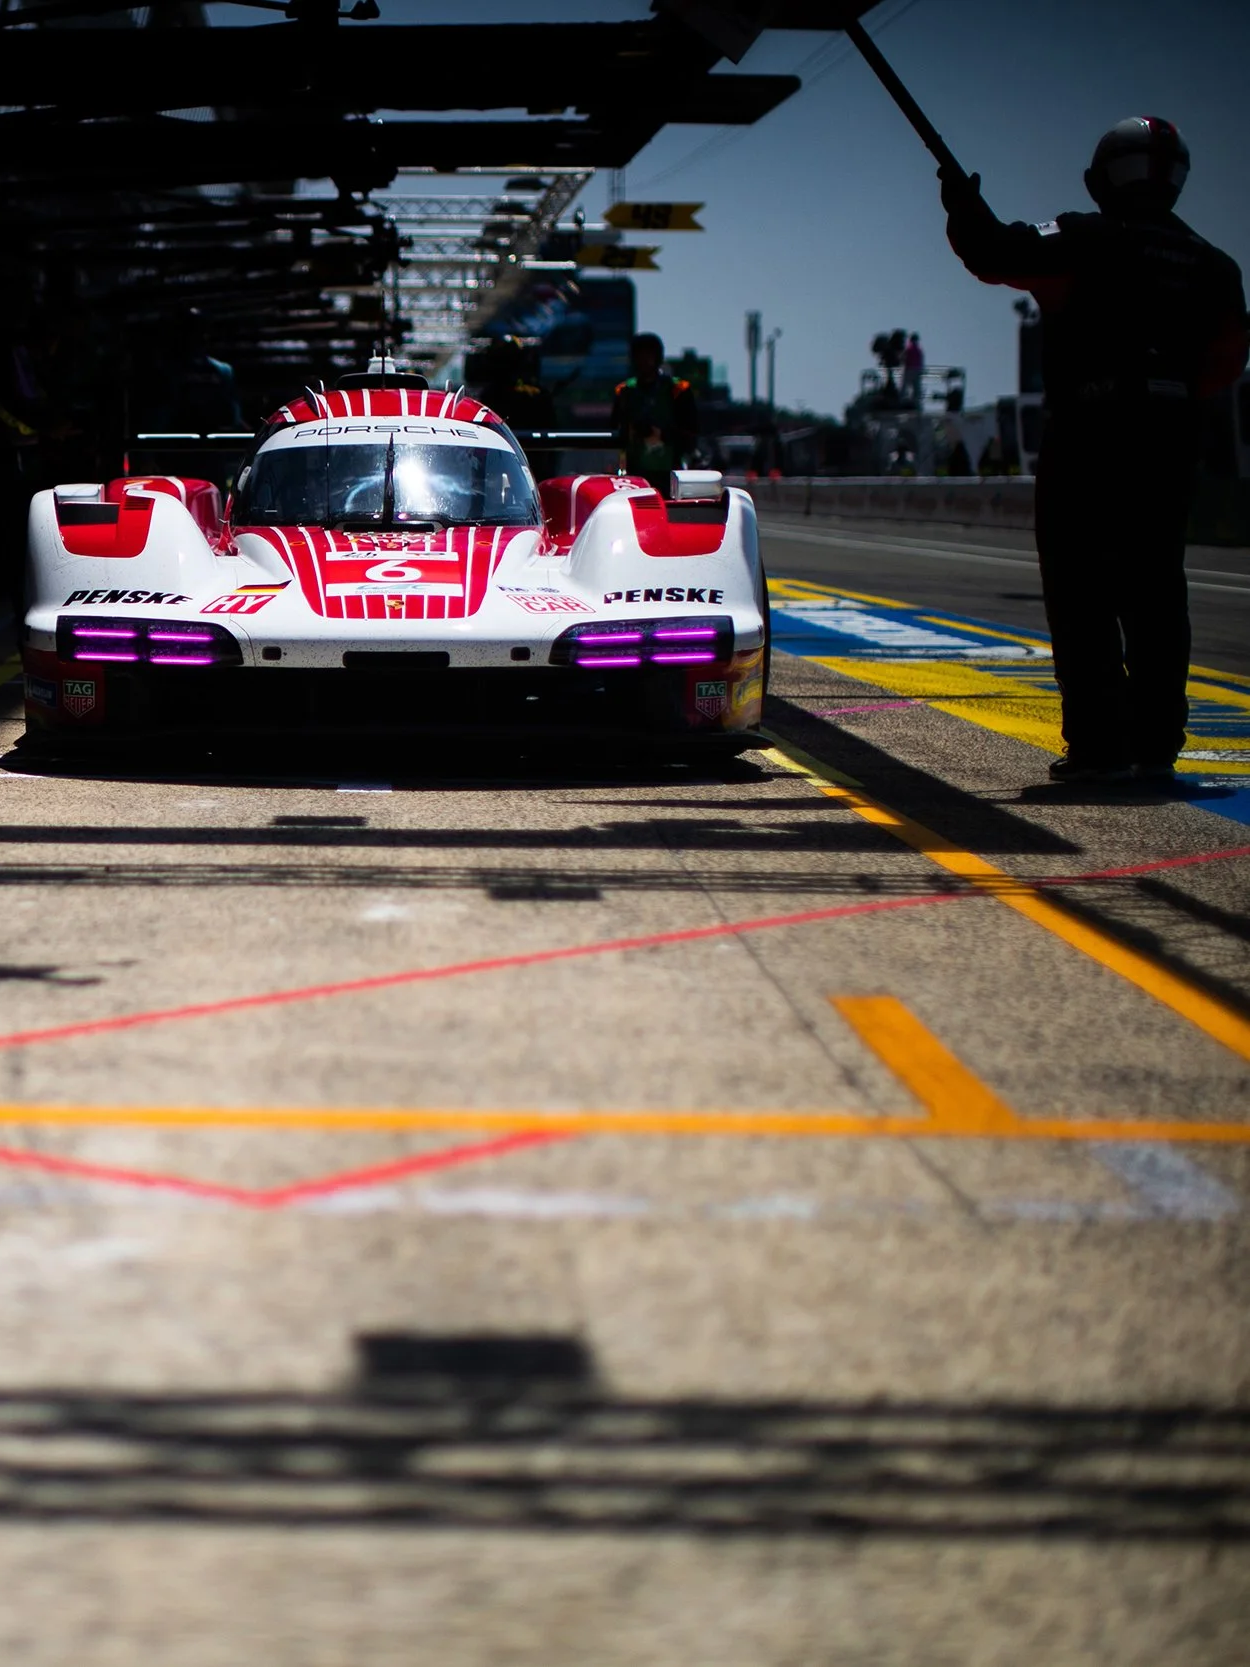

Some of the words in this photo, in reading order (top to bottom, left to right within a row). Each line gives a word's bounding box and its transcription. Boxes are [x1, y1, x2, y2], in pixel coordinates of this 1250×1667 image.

[293, 425, 479, 440] PORSCHE
[365, 560, 422, 582] 6
[62, 589, 193, 607] PENSKE
[200, 594, 277, 613] HY
[512, 594, 574, 602] HYPER
[603, 587, 725, 605] PENSKE
[524, 601, 588, 612] CAR
[65, 682, 92, 695] TAG
[698, 683, 725, 696] TAG
